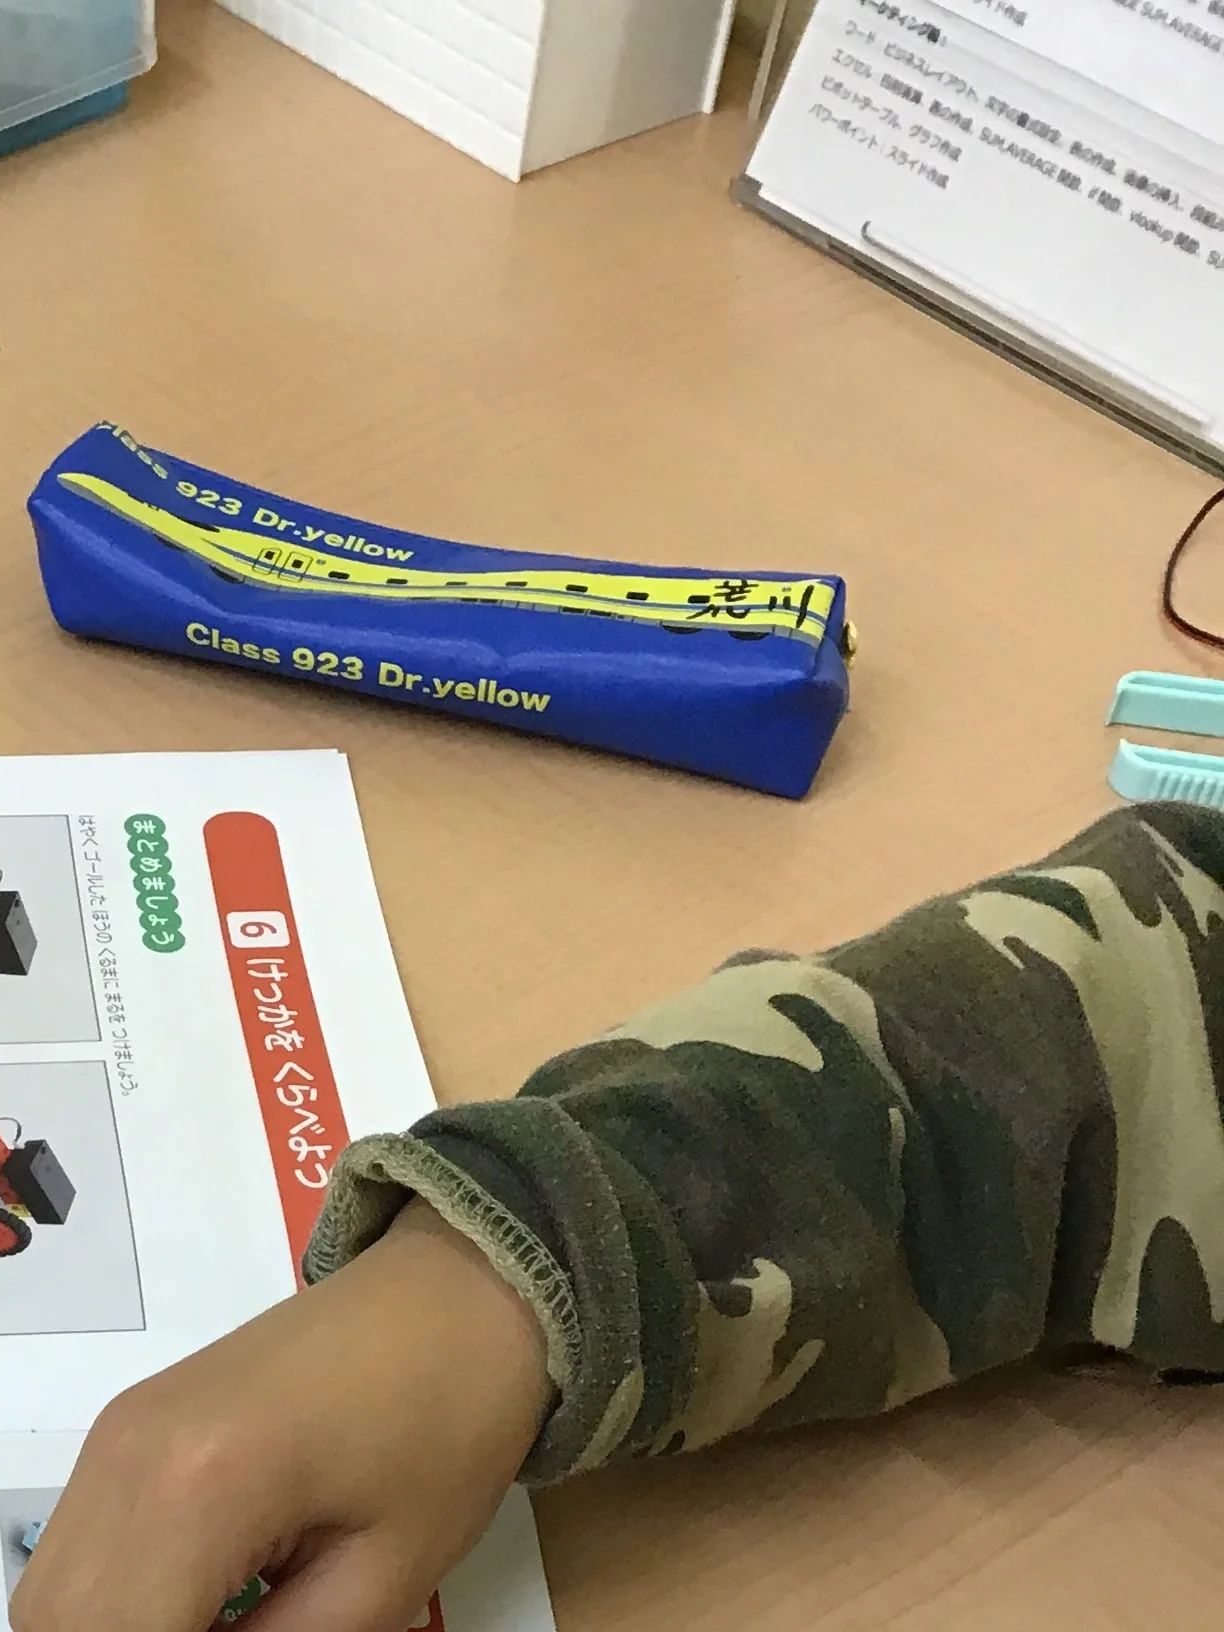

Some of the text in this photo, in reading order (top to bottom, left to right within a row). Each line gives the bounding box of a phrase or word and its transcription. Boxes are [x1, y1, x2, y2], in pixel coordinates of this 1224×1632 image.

[175, 479, 243, 517] 923
[252, 506, 416, 564] Dr.yellow
[185, 621, 552, 714] Class 923 Dr.yellow
[132, 819, 177, 947] まとめましょう
[78, 814, 139, 1097] はやく ゴールした ほうの くるまに まるを つけましょう。
[246, 956, 306, 1051] けっかを
[273, 1061, 334, 1190] くらべよう
